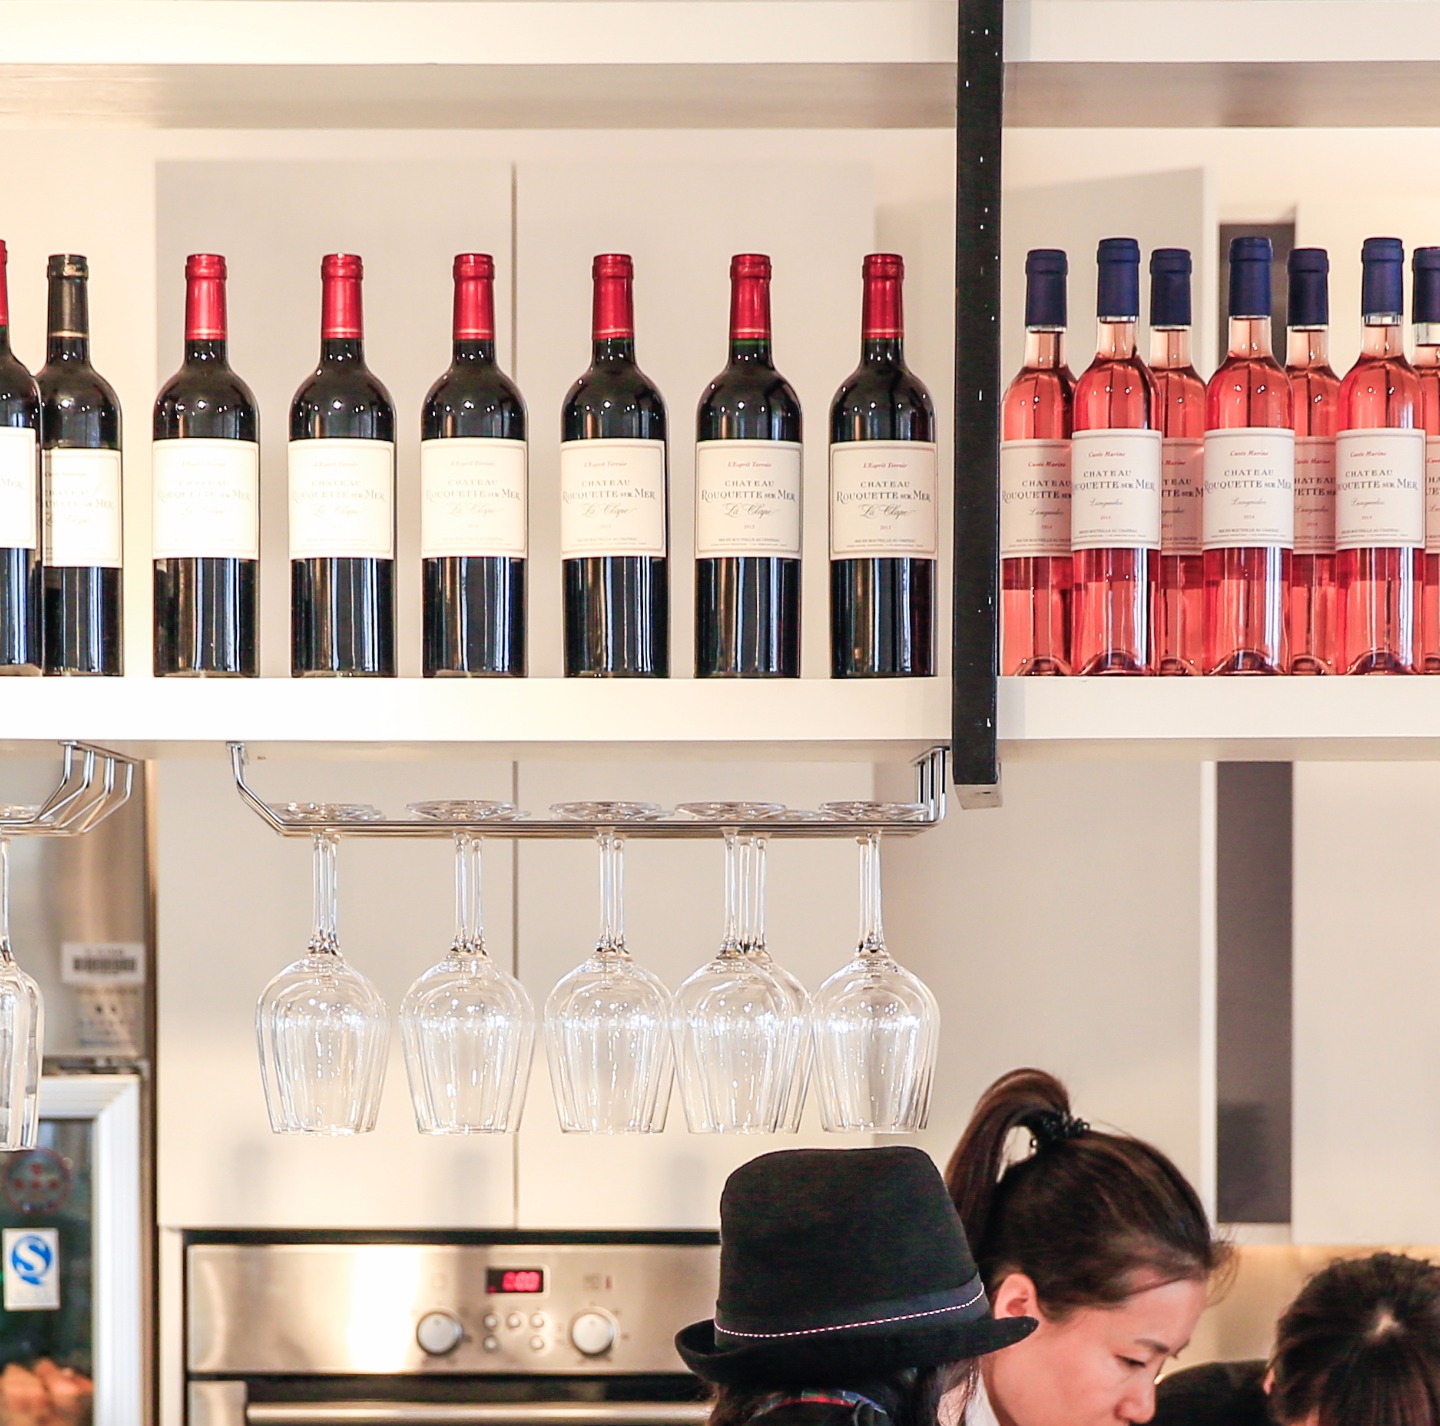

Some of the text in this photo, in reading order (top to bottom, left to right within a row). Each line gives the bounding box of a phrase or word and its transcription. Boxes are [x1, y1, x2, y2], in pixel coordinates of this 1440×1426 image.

[1083, 469, 1132, 478] CHATEAU
[1224, 469, 1274, 477] CHATEAU
[1345, 469, 1393, 477] CHATEAU
